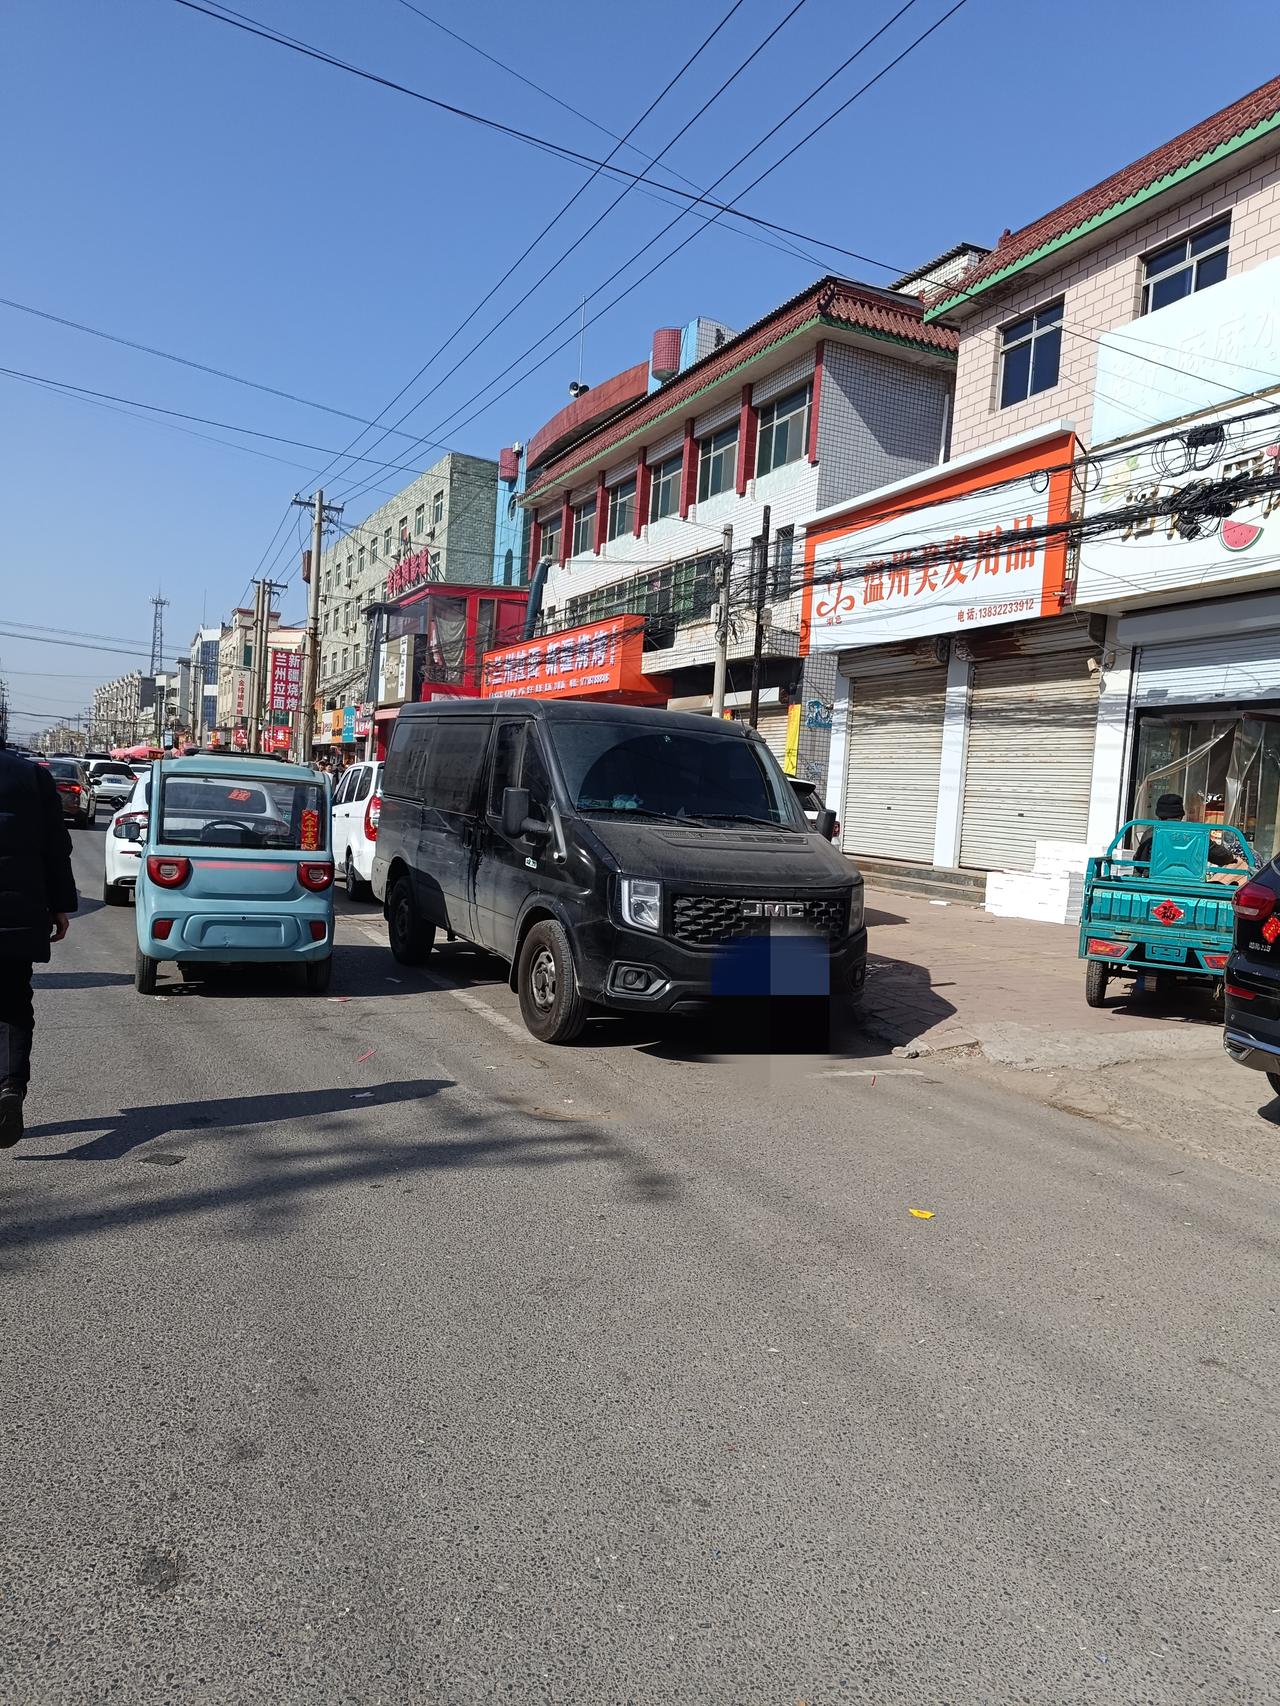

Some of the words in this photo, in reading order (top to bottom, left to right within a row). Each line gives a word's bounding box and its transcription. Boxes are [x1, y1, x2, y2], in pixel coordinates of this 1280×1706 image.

[273, 652, 287, 710] 兰州拉面
[286, 654, 300, 711] 新疆烧烤
[743, 903, 804, 917] JMC
